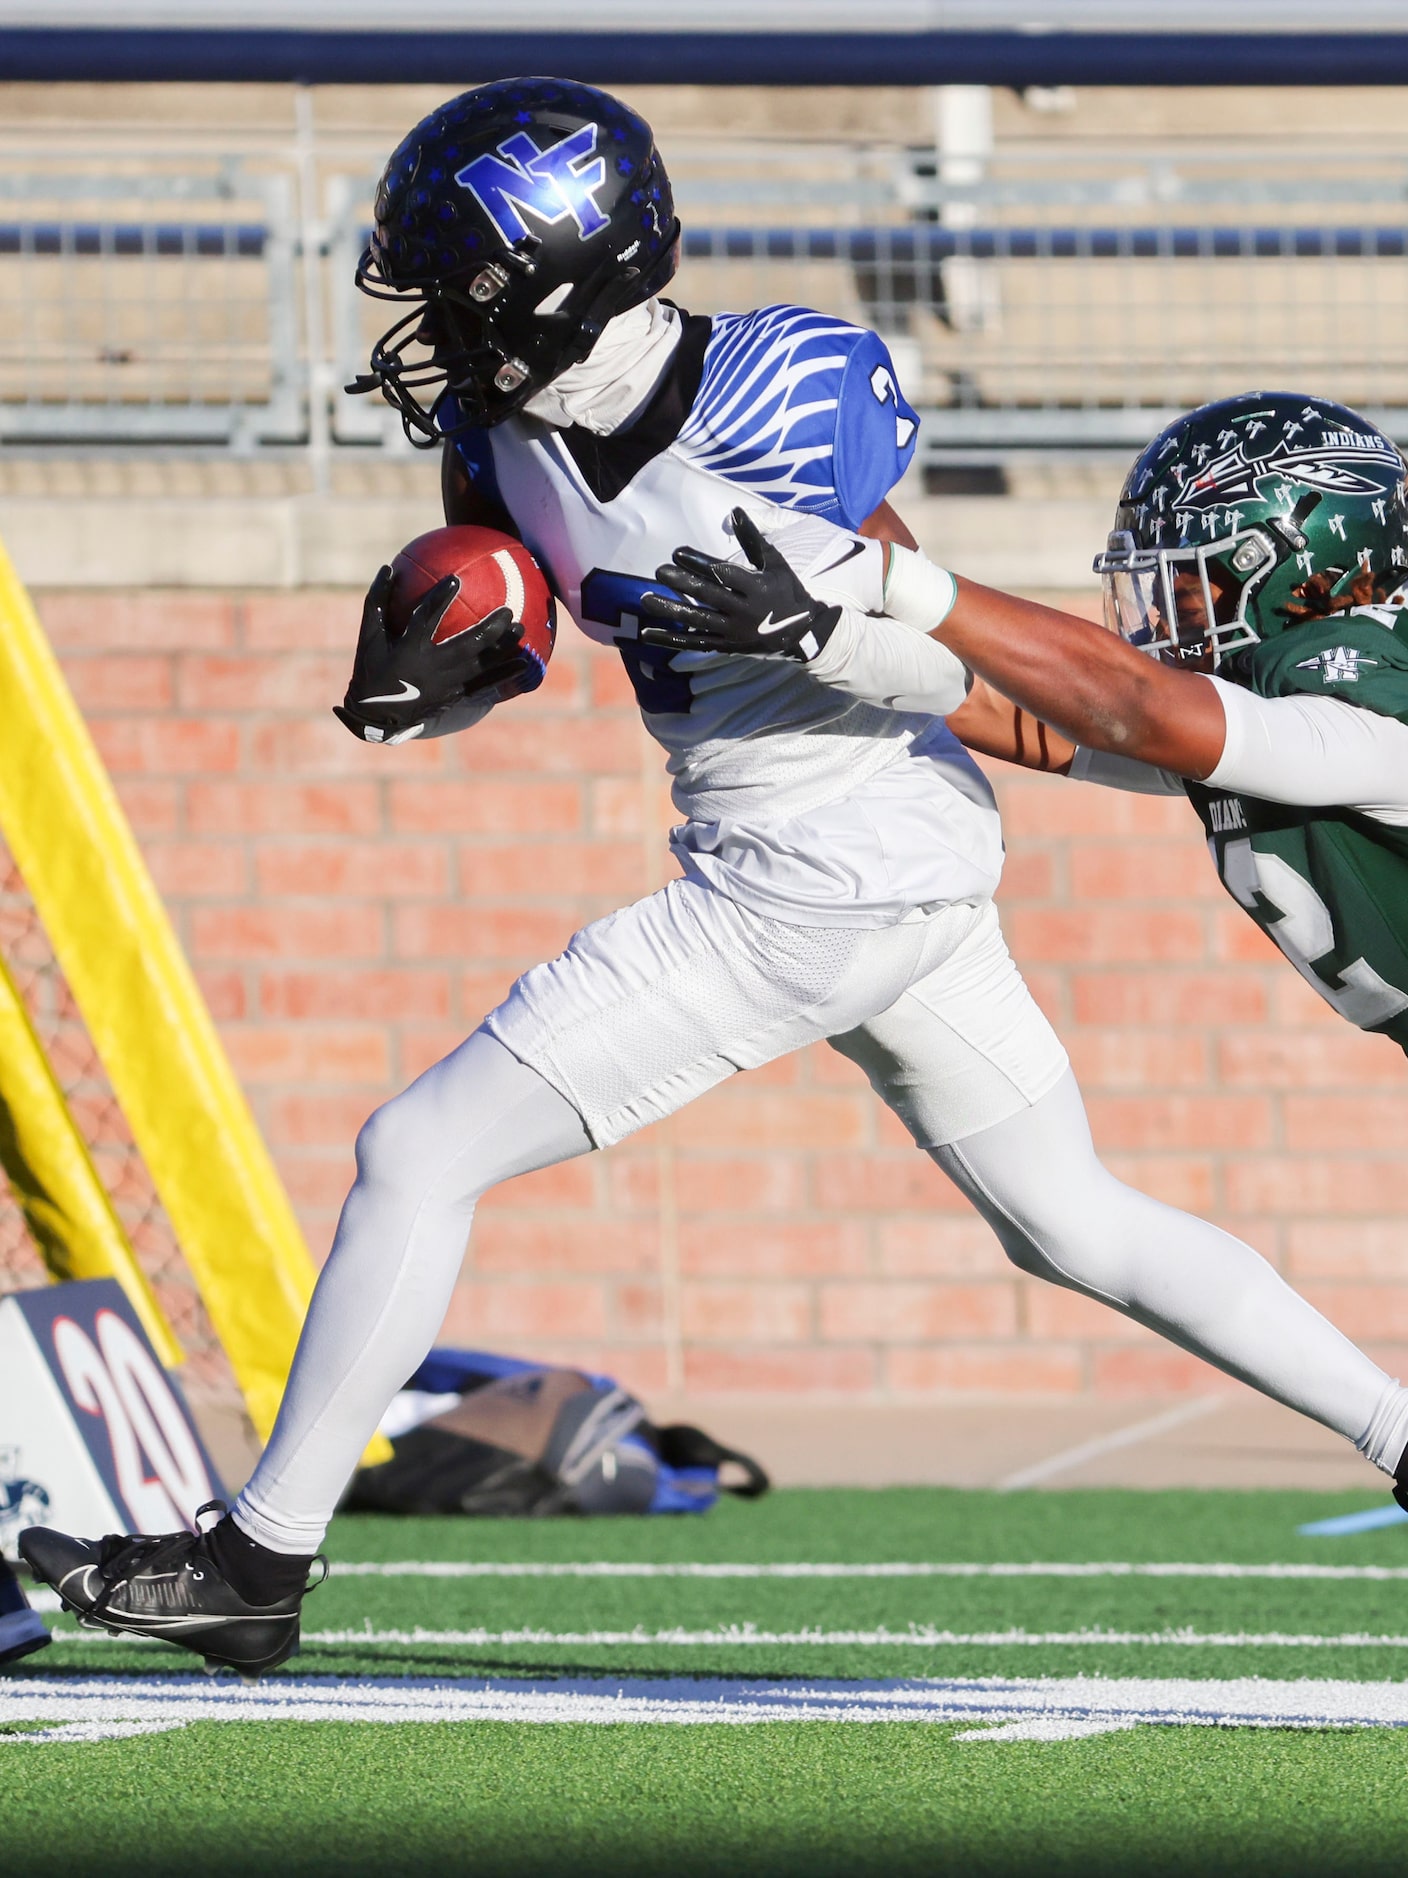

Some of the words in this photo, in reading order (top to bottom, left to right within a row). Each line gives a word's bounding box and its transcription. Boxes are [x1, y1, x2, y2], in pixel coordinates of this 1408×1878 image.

[454, 122, 611, 250] NF
[1321, 431, 1385, 449] INDIANS
[52, 1308, 215, 1535] 20
